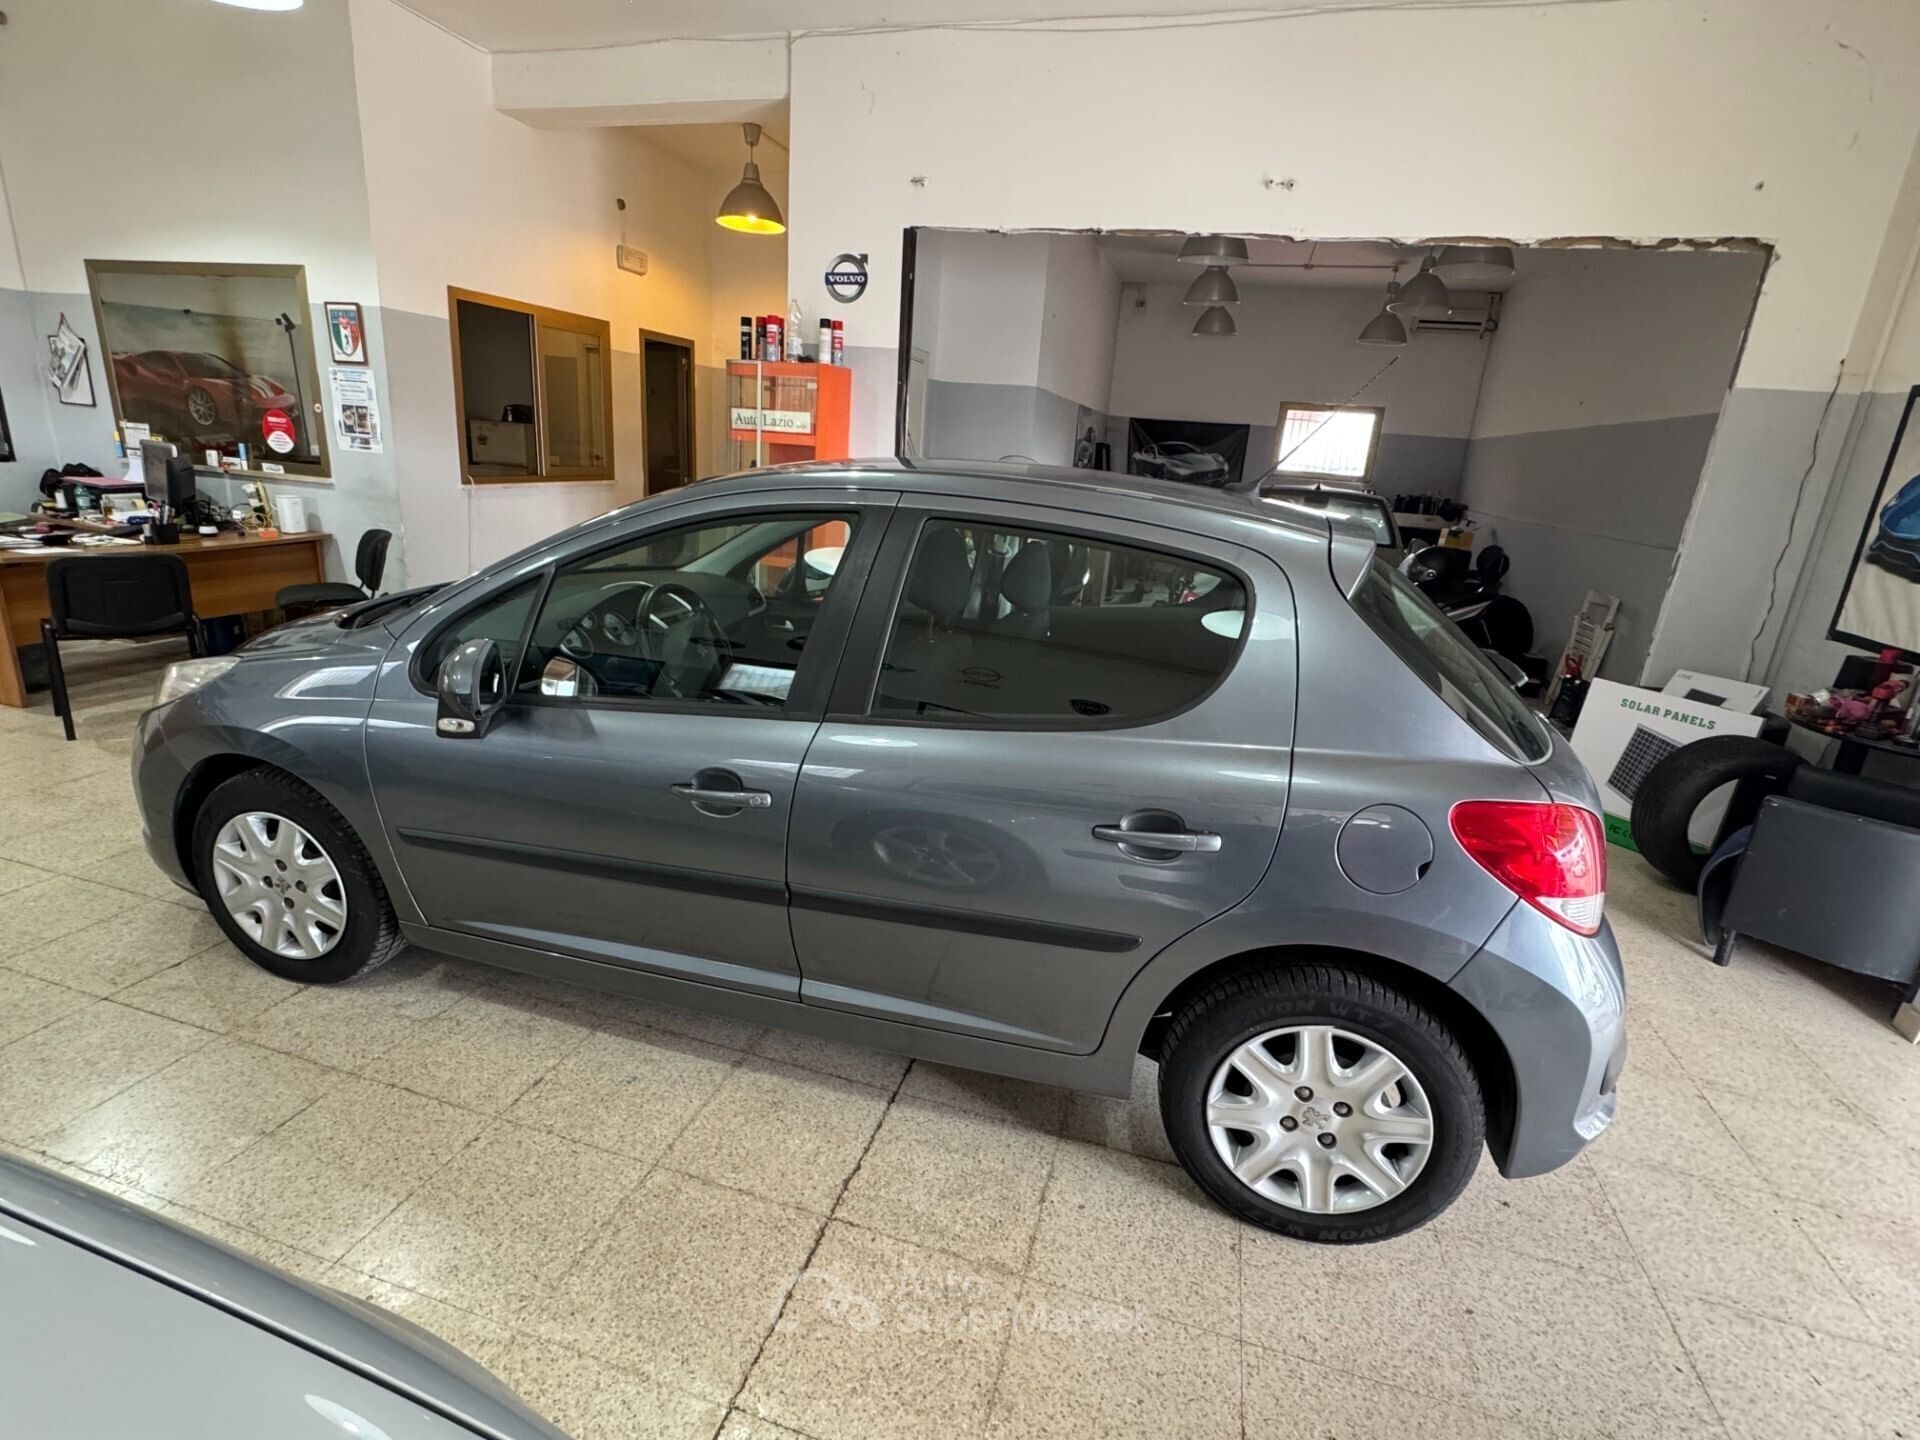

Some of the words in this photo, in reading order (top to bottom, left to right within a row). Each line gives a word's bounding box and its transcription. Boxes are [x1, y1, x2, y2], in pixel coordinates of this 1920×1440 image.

[828, 275, 865, 283] VOLVO
[763, 413, 794, 428] Lazio
[1620, 698, 1661, 716] SOLAR
[1663, 708, 1717, 730] PANELS
